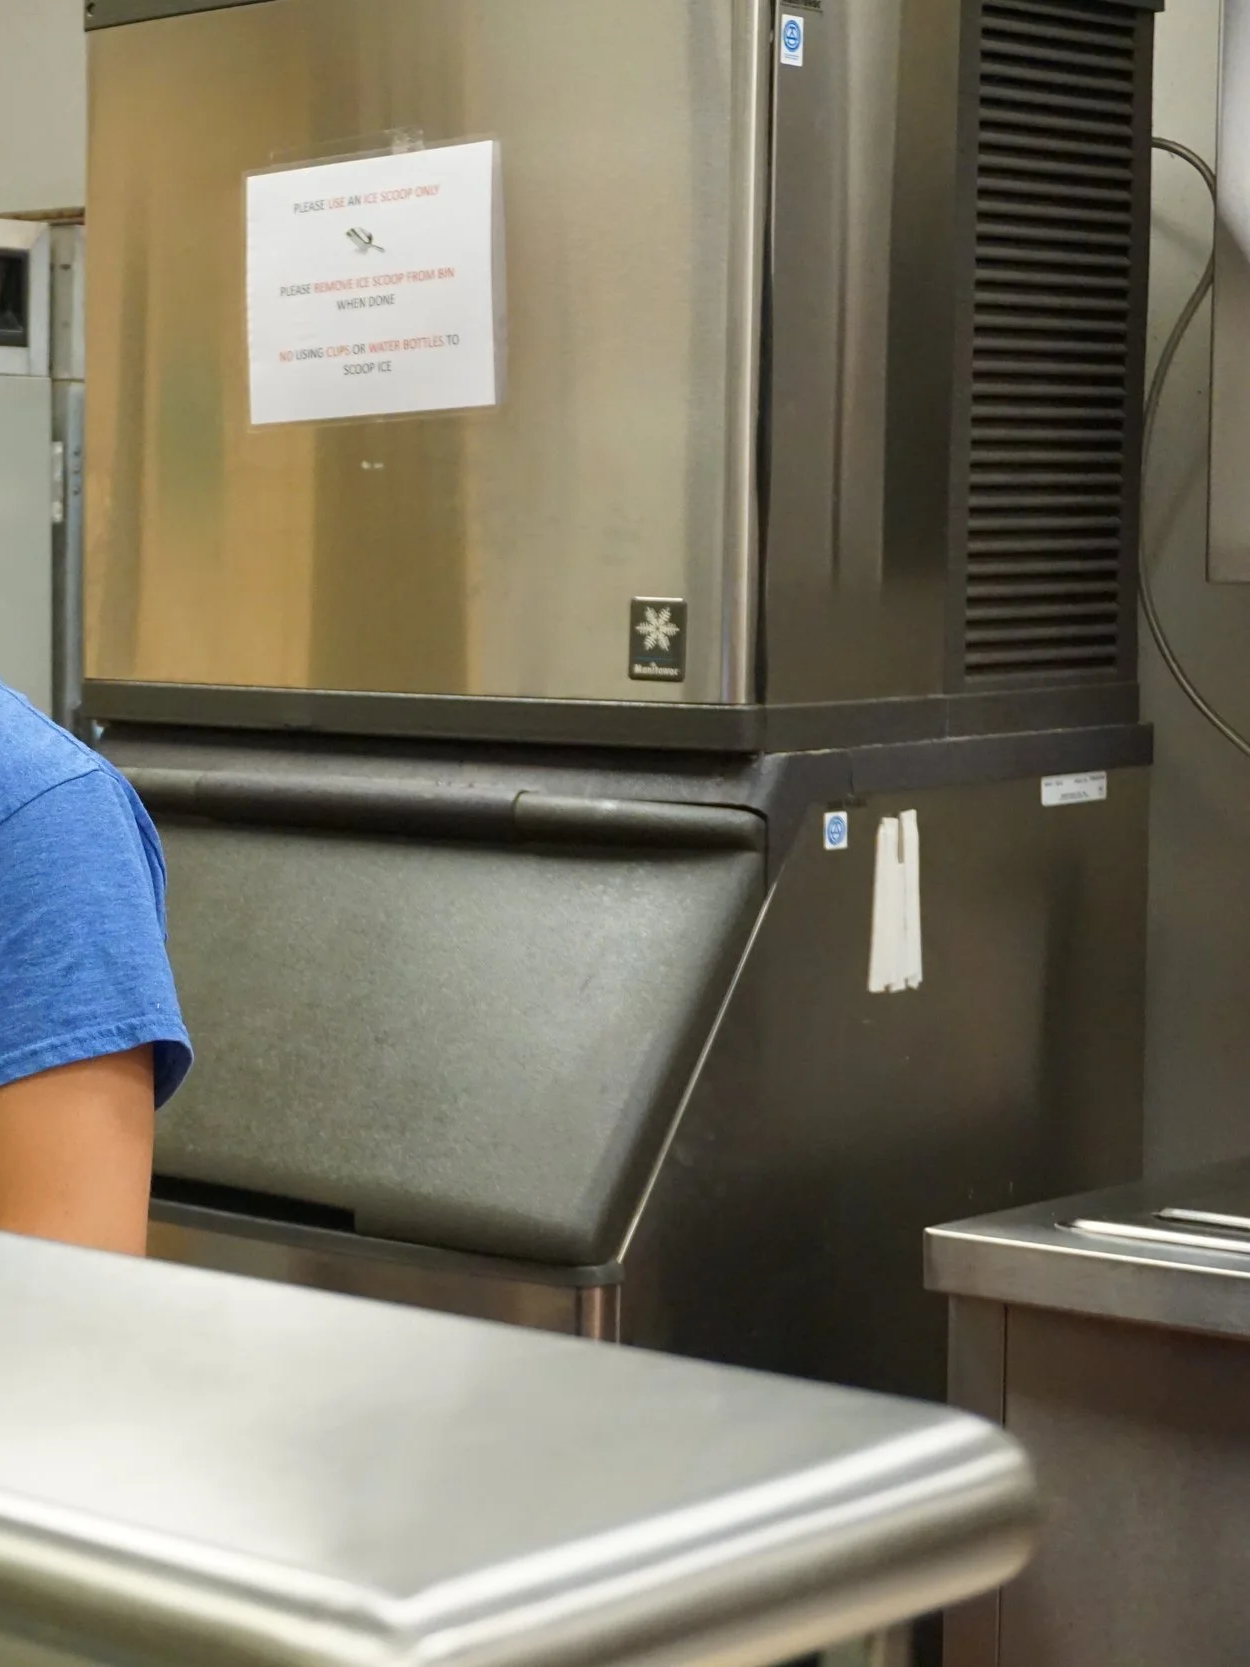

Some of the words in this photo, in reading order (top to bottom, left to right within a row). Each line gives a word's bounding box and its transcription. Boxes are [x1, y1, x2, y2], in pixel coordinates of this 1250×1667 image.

[293, 199, 325, 215] PLEASE
[328, 196, 345, 210] USE
[347, 195, 362, 207] AN
[363, 193, 378, 205] ICE
[380, 187, 413, 203] SCOOP
[415, 184, 440, 198] ONLY
[280, 283, 311, 297] PLEASE
[314, 279, 353, 294] REMOVE
[356, 276, 370, 289] ICE
[372, 273, 404, 288] SCOOP
[407, 269, 436, 283] FROM
[438, 267, 455, 280] BIN
[336, 297, 366, 311] WHEN
[369, 294, 396, 308] DONE
[279, 350, 294, 362] NO
[296, 347, 324, 361] USING
[326, 345, 350, 358] CUPS
[352, 343, 366, 355] OR
[368, 340, 400, 354] WATER
[403, 335, 444, 351] BOTTLES
[447, 333, 460, 346] TO
[343, 361, 375, 376] SCOOP
[378, 360, 393, 373] ICE
[633, 662, 678, 676] Manitowoc
